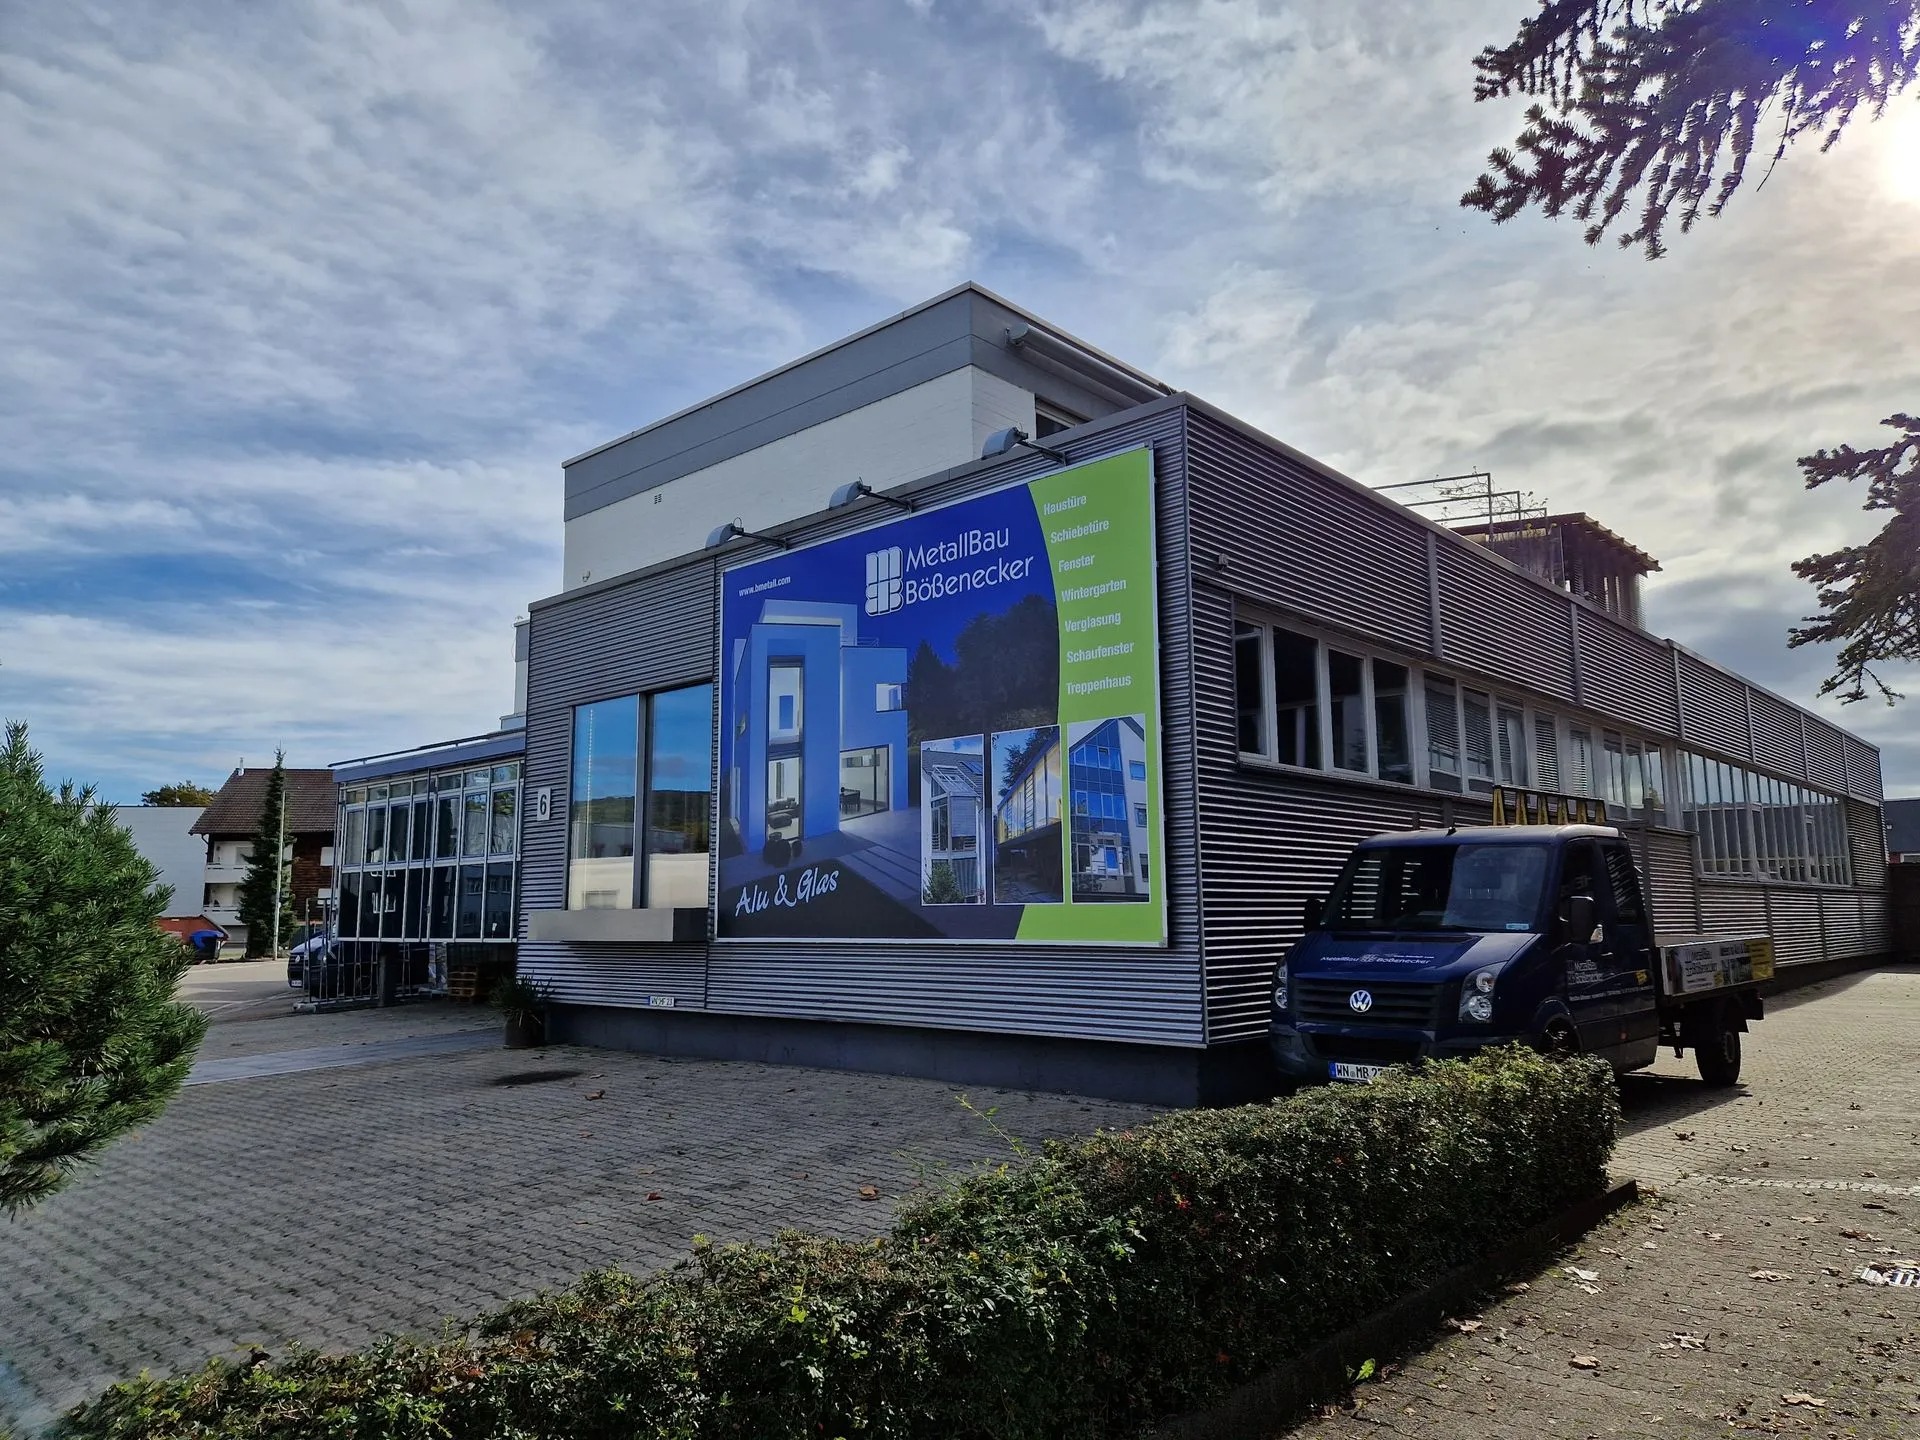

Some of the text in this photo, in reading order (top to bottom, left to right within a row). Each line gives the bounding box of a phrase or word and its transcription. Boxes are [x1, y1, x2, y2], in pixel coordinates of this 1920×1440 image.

[1043, 495, 1087, 516] Haustüre
[1050, 520, 1109, 544] Schiebetüre
[905, 527, 1010, 573] MetallBau
[1058, 554, 1095, 573] Fenster
[738, 576, 791, 597] www.bmetall.com
[905, 555, 1034, 605] Bößenecker
[1061, 579, 1127, 602] Wintergarten
[1064, 612, 1121, 633] Verglasung
[1066, 642, 1135, 664] Schaufenster
[1066, 675, 1132, 695] Treppenhaus
[540, 794, 547, 816] 6
[735, 866, 839, 917] Alu & Glas
[1336, 1065, 1349, 1077] WN
[1355, 1066, 1369, 1079] MB
